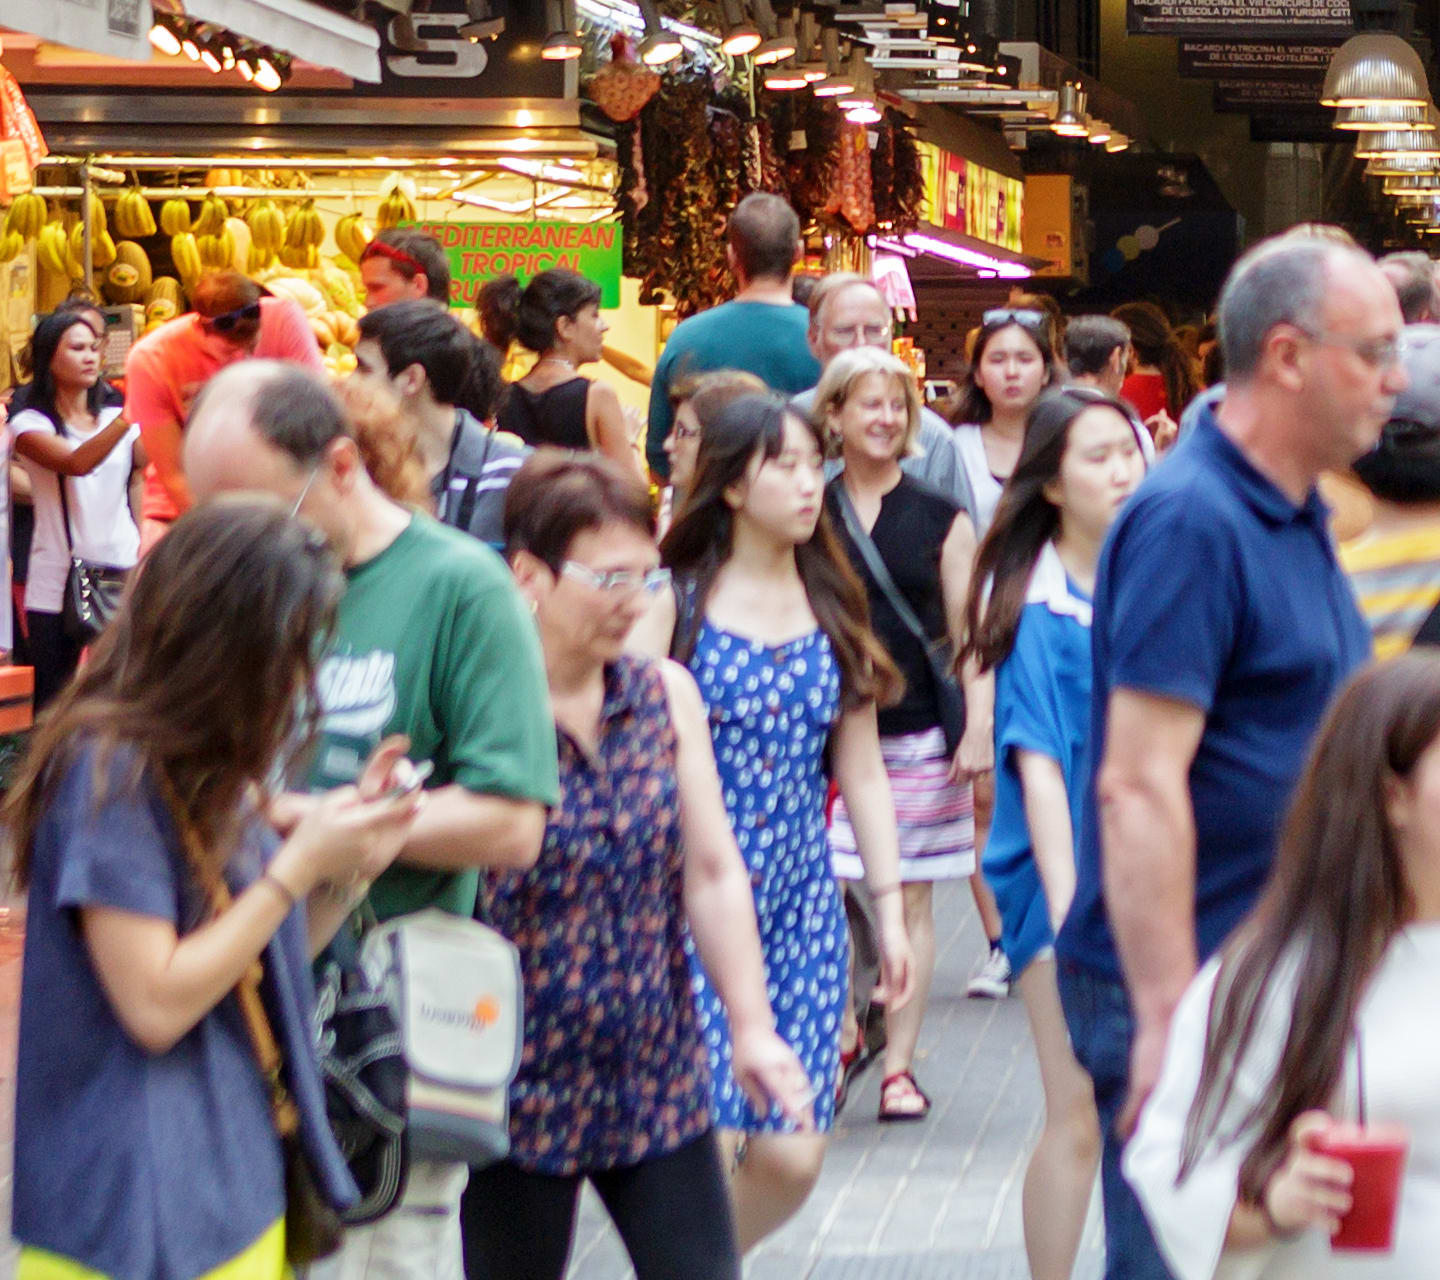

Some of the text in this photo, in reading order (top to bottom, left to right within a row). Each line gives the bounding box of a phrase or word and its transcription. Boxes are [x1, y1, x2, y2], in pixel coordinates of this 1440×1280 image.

[1161, 7, 1173, 16] DE
[1222, 8, 1283, 17] D'HOTELERIA
[1290, 8, 1329, 17] TURISME
[407, 223, 615, 249] MEDITERRANEAN
[462, 252, 582, 276] TROPICAL
